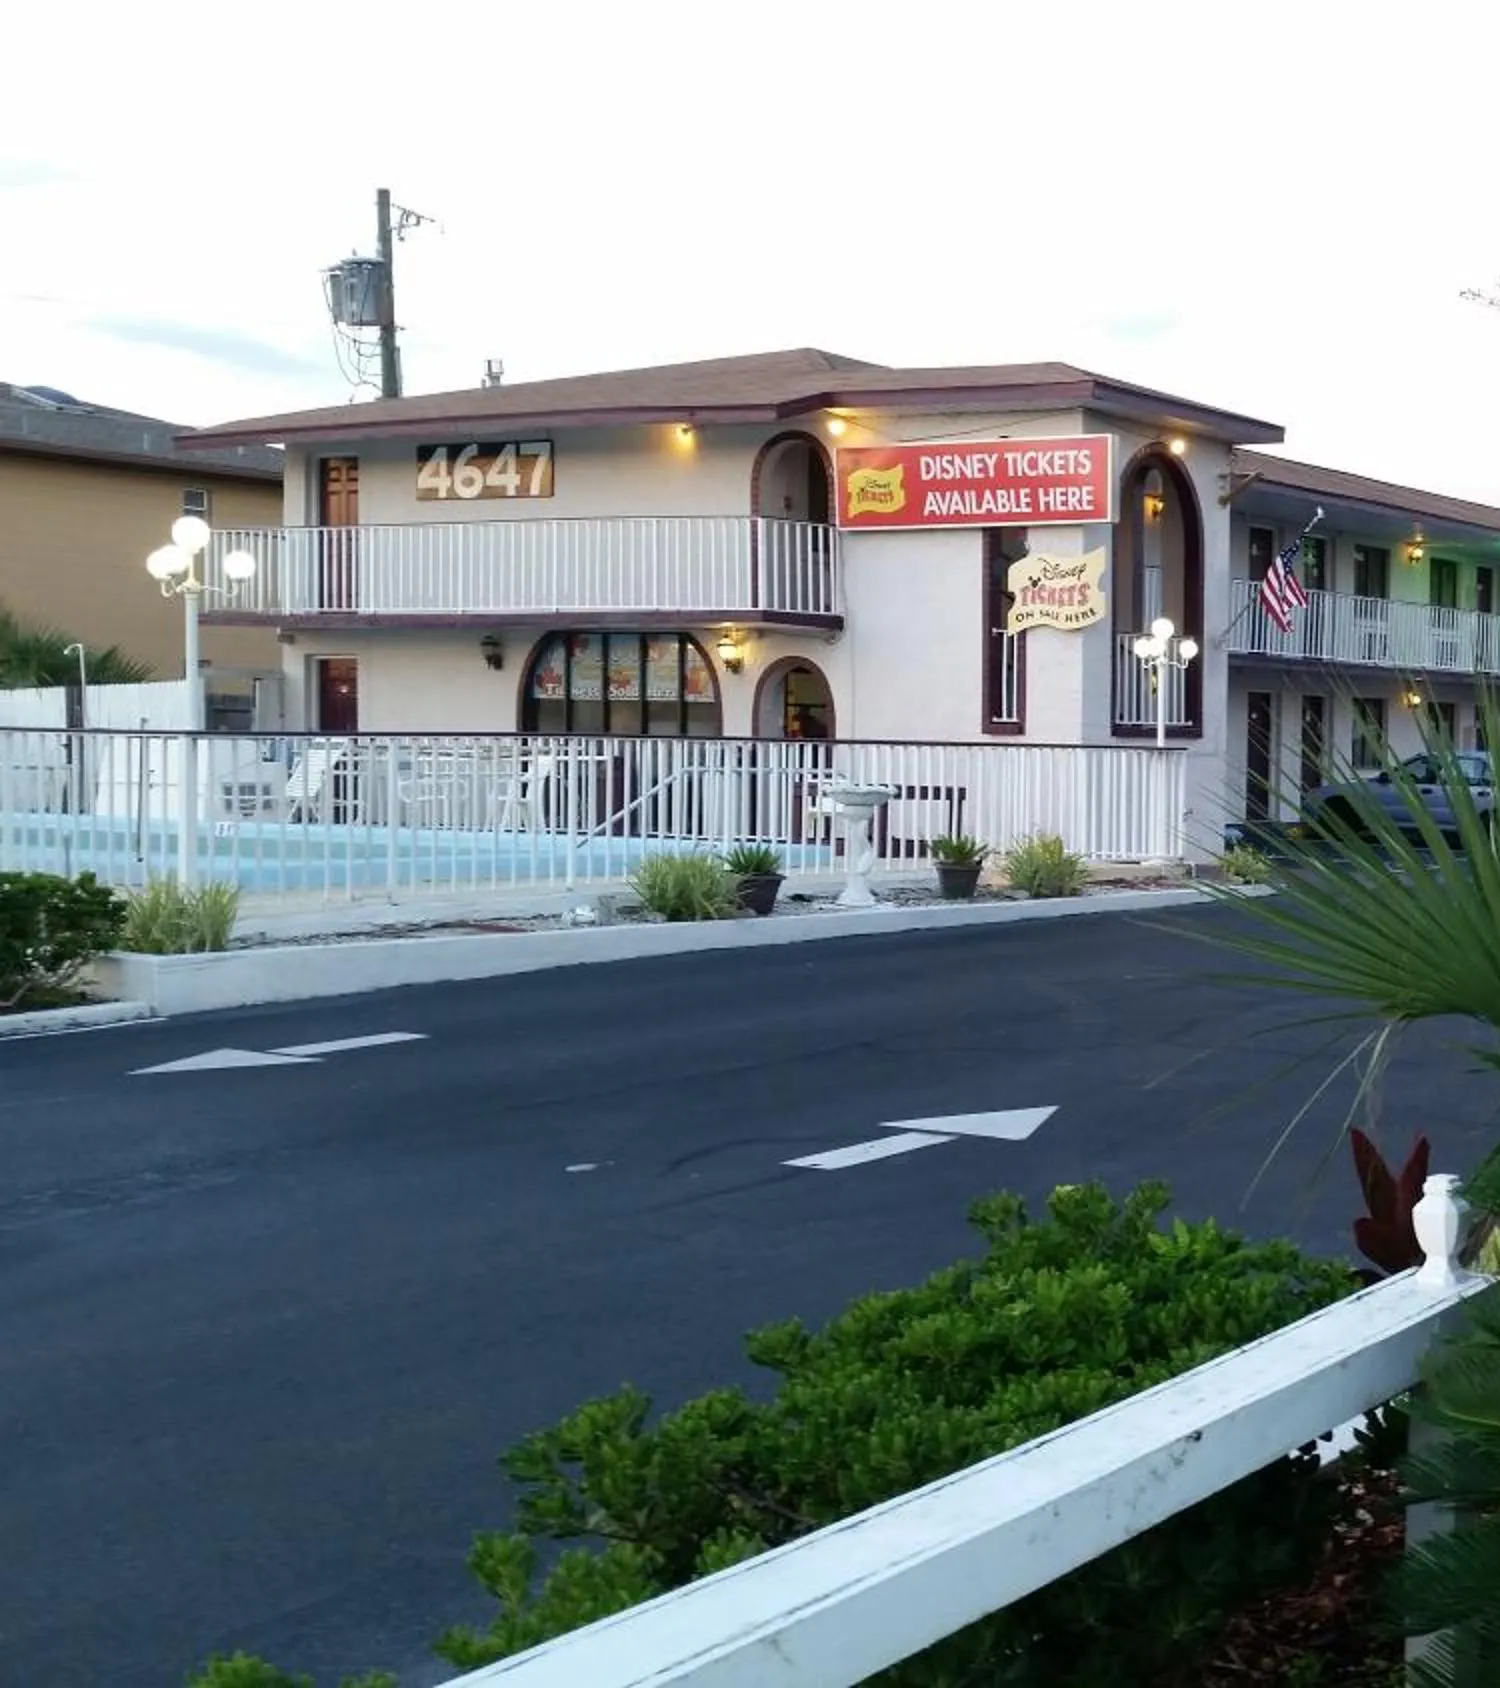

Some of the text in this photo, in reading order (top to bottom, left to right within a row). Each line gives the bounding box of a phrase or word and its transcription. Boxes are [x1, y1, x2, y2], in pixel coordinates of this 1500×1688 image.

[417, 441, 551, 498] 4647
[920, 449, 1092, 481] DISNEY TICKETS
[923, 485, 1094, 516] AVAILABLE HERE
[1015, 610, 1034, 623] ON
